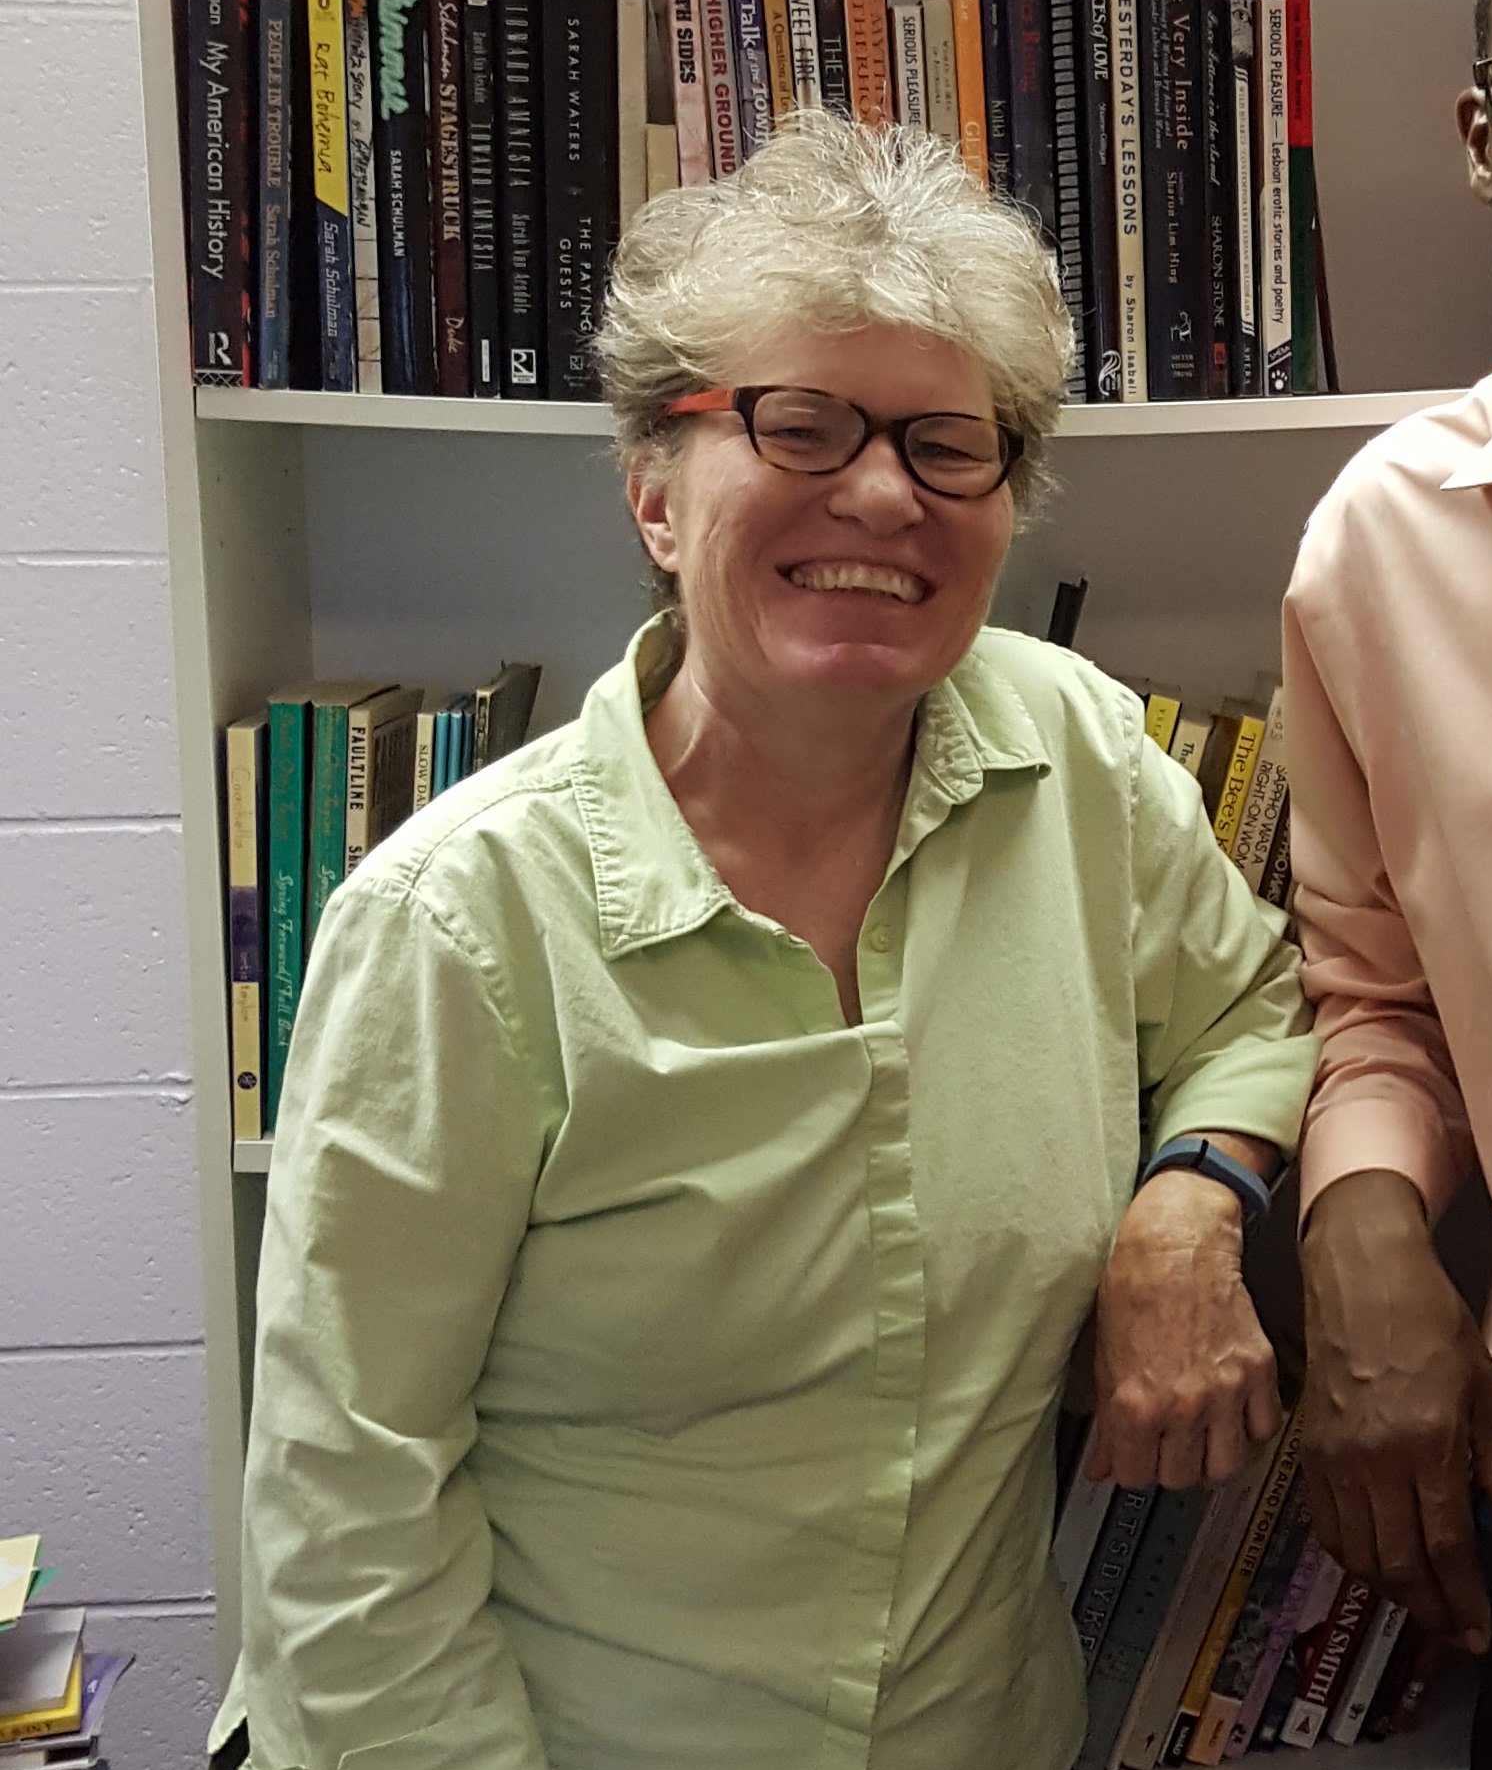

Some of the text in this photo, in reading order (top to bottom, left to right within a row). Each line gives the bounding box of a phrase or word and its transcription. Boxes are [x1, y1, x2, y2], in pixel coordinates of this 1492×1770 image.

[199, 40, 226, 72] My
[676, 28, 696, 84] SIDES
[740, 0, 769, 147] Talk the Town
[772, 24, 787, 78] Question
[795, 48, 816, 85] FIRE
[822, 36, 841, 73] THE
[903, 16, 921, 125] SERIOUS PLEASURE
[1090, 24, 1108, 38] of
[1094, 44, 1109, 80] LOVE
[1170, 14, 1190, 67] Very
[267, 19, 283, 188] PEOPLE IN TROUBLE
[314, 42, 337, 174] Rat Bohemia
[438, 1, 461, 241] Schulman STAGESTRUCK
[505, 6, 531, 189] TOWARD AMNESIA
[566, 18, 582, 162] SARAH WATERS
[714, 83, 736, 175] GROUND
[1175, 80, 1194, 150] Inside
[205, 85, 228, 192] American
[1269, 9, 1287, 324] SERIOUS PLEASURE Lesbian erotic stories and poetry
[389, 149, 404, 258] SARAH SCHULMAN
[471, 122, 494, 272] TOWARD AMNESIA
[1119, 139, 1137, 235] LESSONS
[1166, 171, 1178, 217] Sharon
[201, 199, 231, 280] History
[264, 204, 280, 318] Sarah Schulman
[324, 222, 341, 337] Sarah Schulman
[512, 213, 531, 317] Sarah Van Arsdale
[559, 238, 572, 310] GUESTS
[579, 218, 593, 332] THE PAYING
[1212, 216, 1224, 327] SHARON STONE
[446, 317, 464, 354] Duke
[1124, 275, 1136, 343] by Sharon
[350, 727, 366, 811] FAULTLINE
[417, 744, 429, 780] SLOW
[1219, 733, 1257, 831] The Bee's
[1248, 760, 1273, 824] RIGHT-ON
[1251, 765, 1286, 864] SAPPHO WAS A
[1307, 1630, 1349, 1705] SMITH
